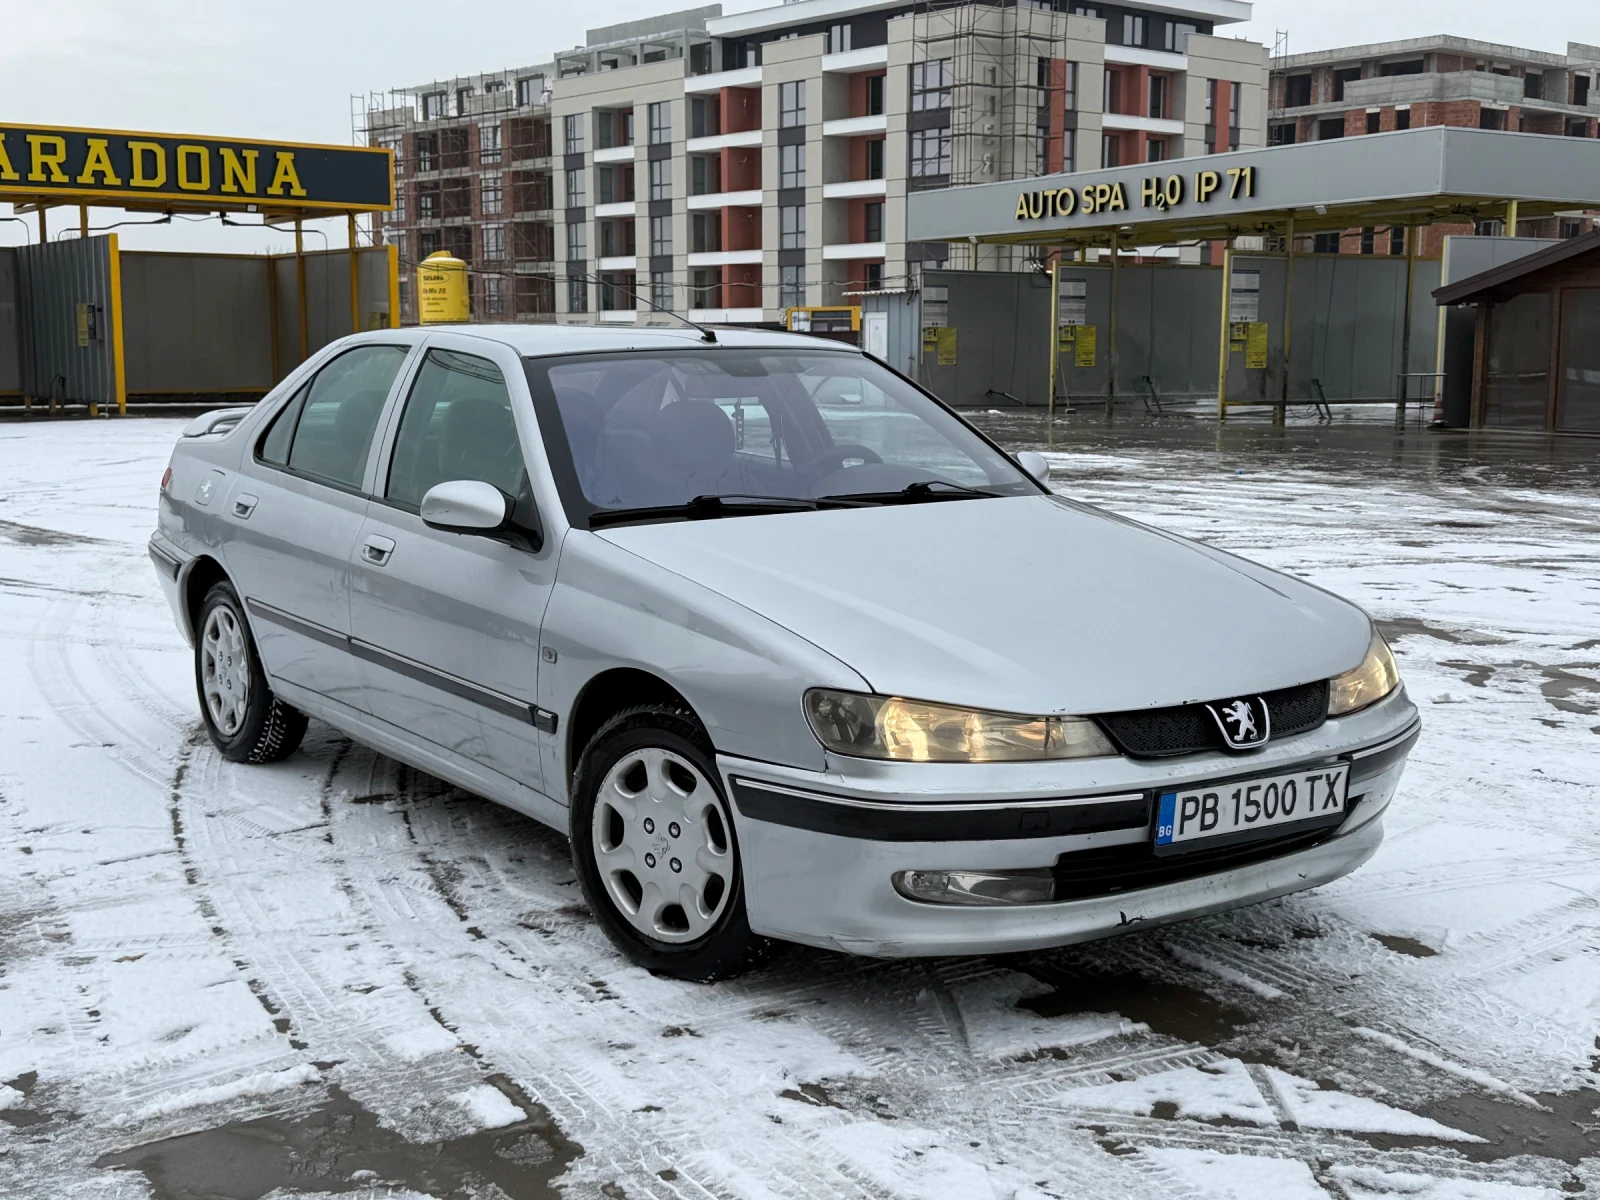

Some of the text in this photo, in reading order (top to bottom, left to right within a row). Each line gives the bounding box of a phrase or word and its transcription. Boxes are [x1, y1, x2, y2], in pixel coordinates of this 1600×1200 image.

[1014, 187, 1076, 220] AUTO
[1081, 182, 1127, 214] SPA
[1194, 170, 1219, 203] IP
[1226, 166, 1253, 199] 71
[1178, 771, 1342, 836] PB 1500 TX
[1158, 825, 1172, 837] BG
